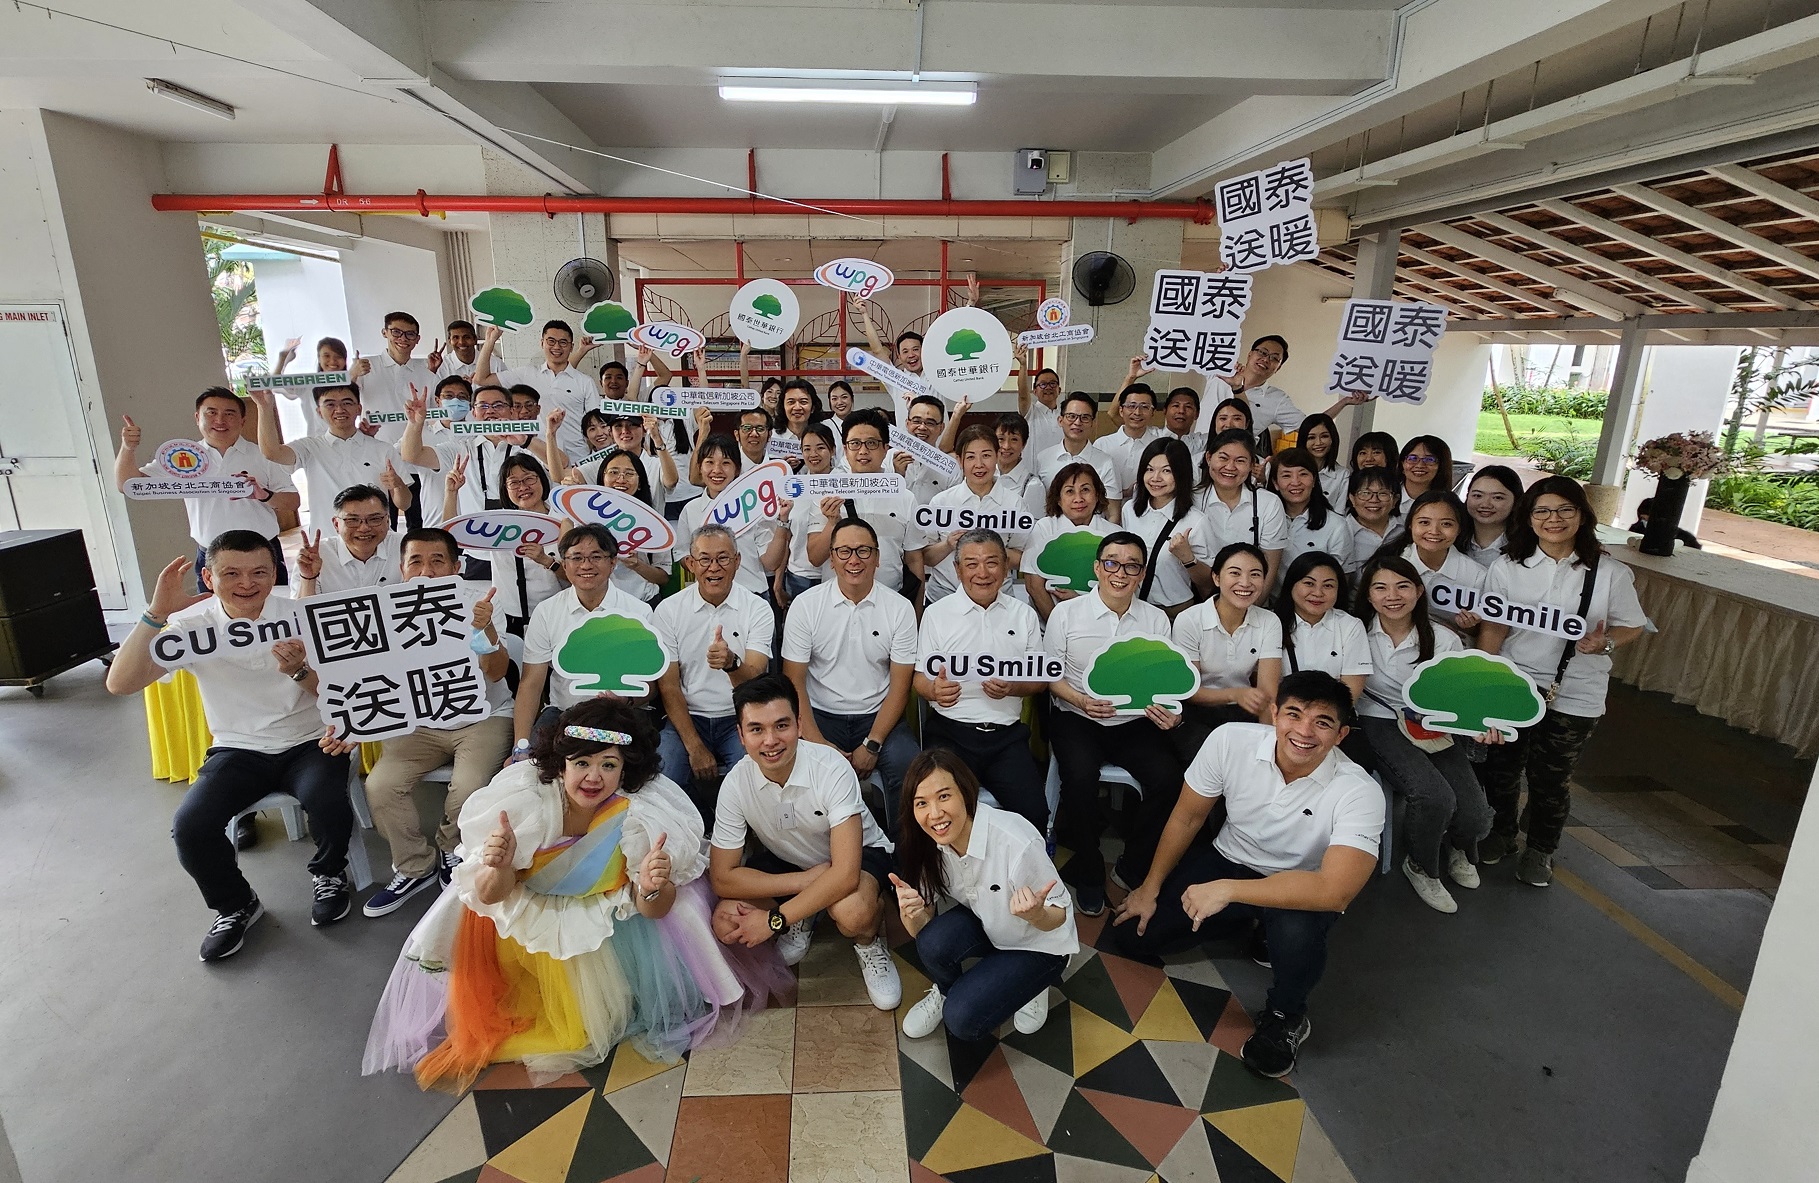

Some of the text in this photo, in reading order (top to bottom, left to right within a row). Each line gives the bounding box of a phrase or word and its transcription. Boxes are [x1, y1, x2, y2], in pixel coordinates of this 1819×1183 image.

[1219, 163, 1309, 223] 國泰
[1224, 214, 1315, 272] 送暖
[835, 263, 879, 297] wpg
[1155, 274, 1248, 320] 國泰
[5, 312, 26, 321] MAIN
[27, 312, 49, 321] INLET
[1342, 303, 1443, 349] 國泰
[648, 325, 691, 357] wpg
[1146, 327, 1238, 373] 送暖
[249, 373, 347, 388] EVERGREEN
[937, 363, 999, 378] 國泰世華銀行
[1329, 353, 1429, 401] 送暖
[603, 401, 687, 417] EVERGREEN
[681, 391, 755, 401] 中華電信新加坡公司
[369, 409, 449, 424] EVEREEN
[453, 422, 540, 434] EVERGREEN
[131, 481, 245, 491] 新加坡台北工商協會
[809, 478, 899, 488] 中華電信新加坡公司
[713, 479, 779, 525] wpg
[915, 508, 1033, 530] CU Smile
[465, 518, 545, 556] wpg
[587, 491, 653, 555] wpg
[304, 582, 467, 664] 國泰
[1431, 584, 1583, 636] CU Smile
[154, 611, 301, 662] CU Smi
[926, 655, 1062, 677] CU Smile
[326, 657, 484, 741] 送暖
